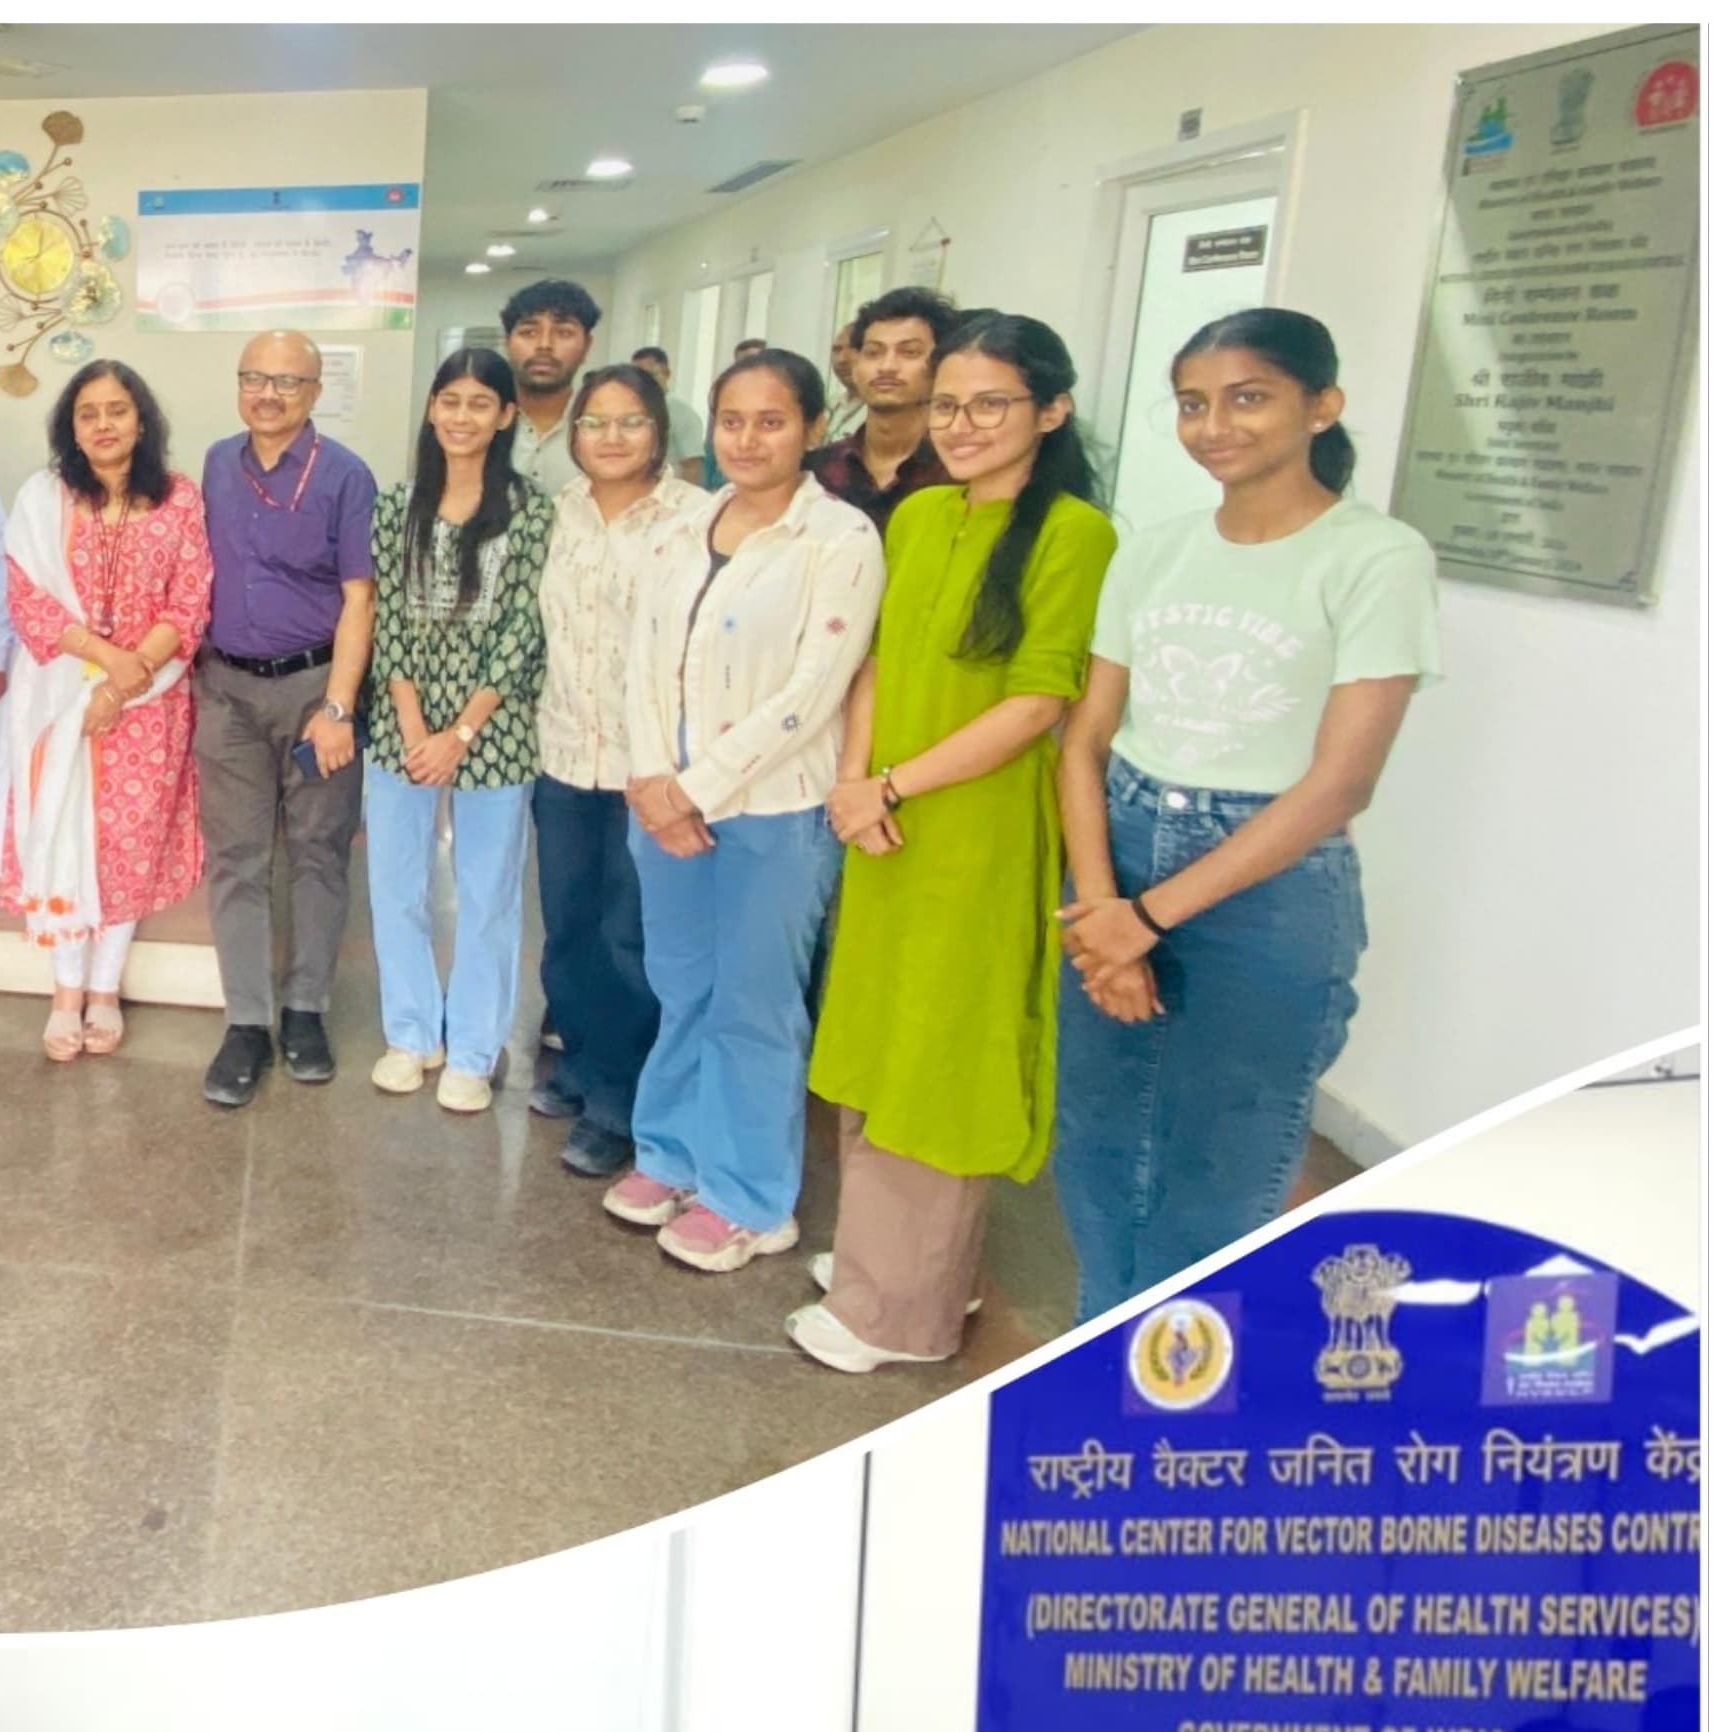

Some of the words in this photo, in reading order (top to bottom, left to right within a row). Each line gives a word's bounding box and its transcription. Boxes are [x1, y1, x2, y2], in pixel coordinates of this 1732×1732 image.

[1028, 1438, 1135, 1499] राष्ट्रीय
[1153, 1437, 1249, 1489] वैक्टर
[1268, 1433, 1374, 1487] जनित
[1394, 1429, 1460, 1484] रोग
[1481, 1427, 1621, 1483] नियंत्रण
[1001, 1519, 1113, 1556] NATIONAL
[1120, 1517, 1213, 1555] CENTER
[1220, 1516, 1268, 1554] FOR
[1275, 1515, 1373, 1554] VECTOR
[1380, 1515, 1467, 1554] BORNE
[1475, 1513, 1604, 1554] DISEASES
[1026, 1593, 1219, 1640] (DIRECTORATE
[1227, 1594, 1359, 1633] GENERAL
[1367, 1594, 1405, 1634] OF
[1412, 1595, 1530, 1635] HEALTH
[1063, 1653, 1193, 1691] MINISTRY
[1199, 1655, 1237, 1692] OF
[1243, 1656, 1355, 1694] HEALTH
[1362, 1657, 1383, 1695] &
[1394, 1657, 1498, 1698] FAMILY
[1506, 1660, 1648, 1702] WELFARE
